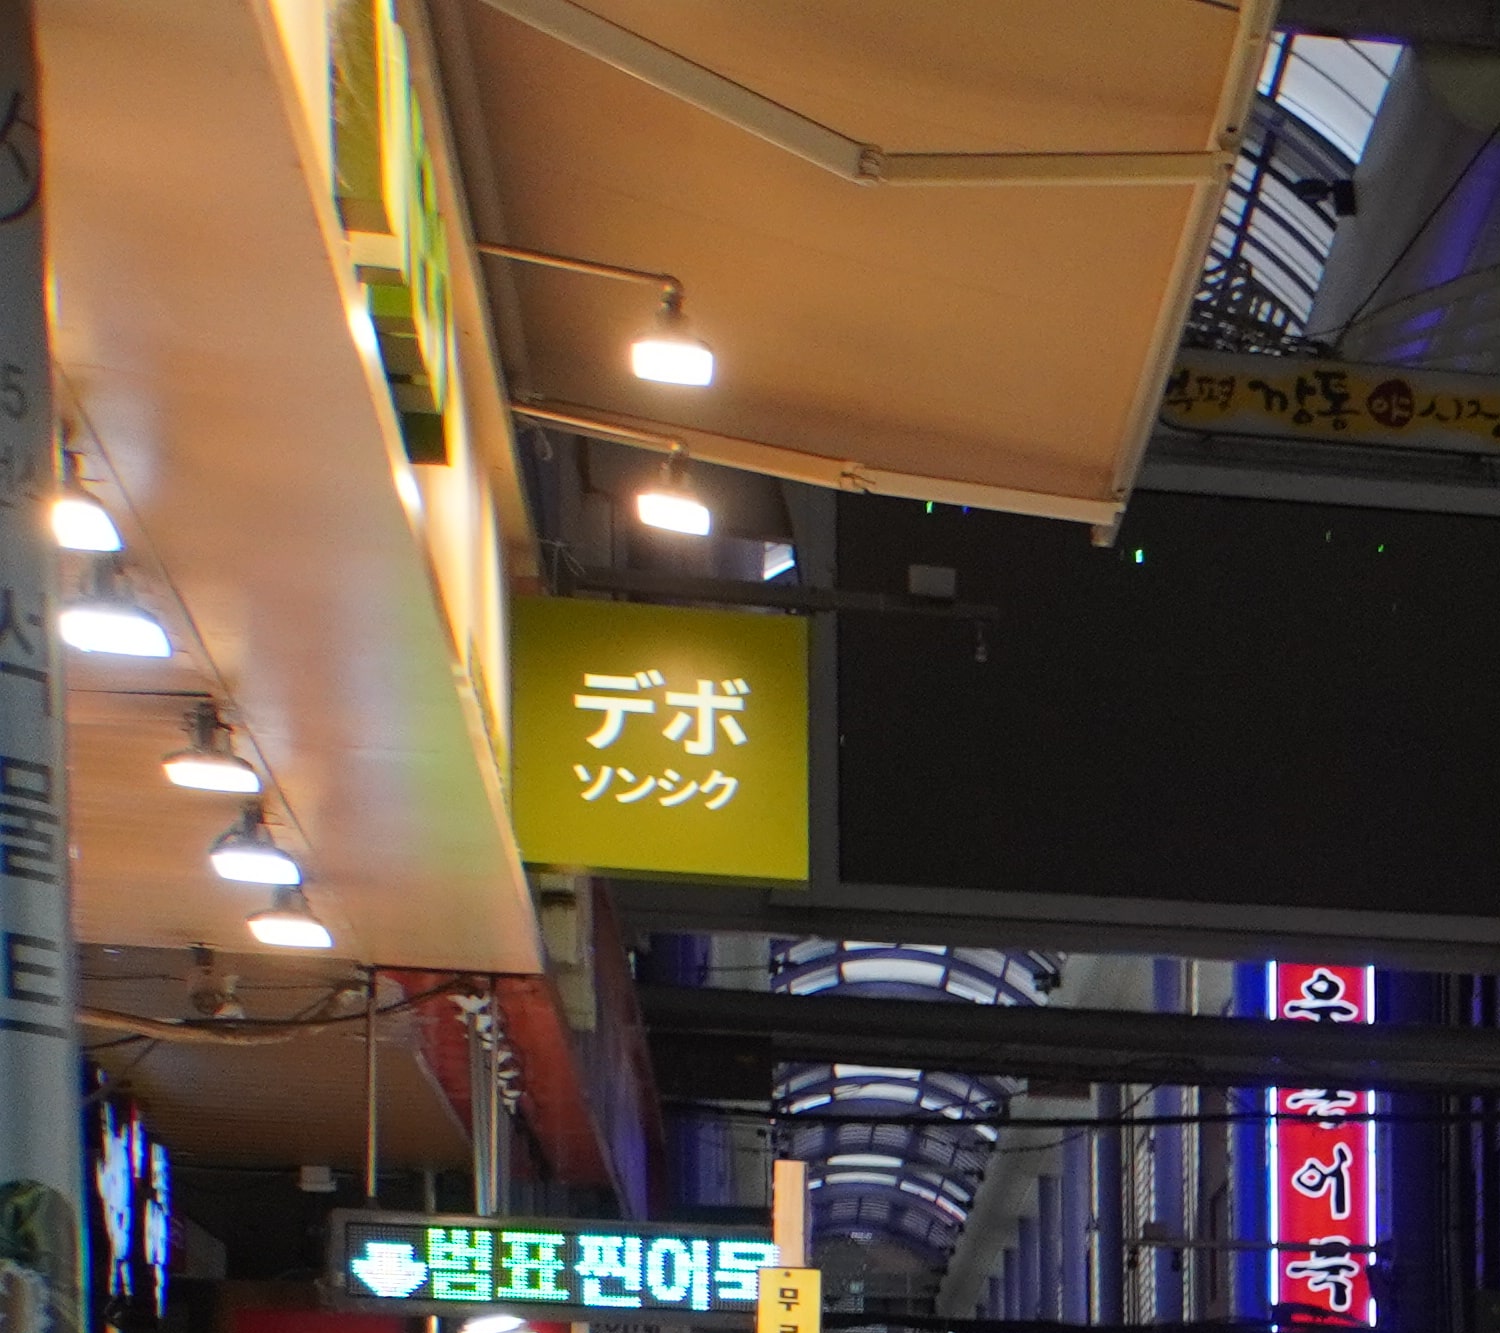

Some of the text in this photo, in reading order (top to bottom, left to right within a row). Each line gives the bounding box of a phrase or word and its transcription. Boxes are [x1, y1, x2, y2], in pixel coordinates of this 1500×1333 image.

[573, 668, 751, 756] デボ
[572, 762, 739, 811] ソンシク
